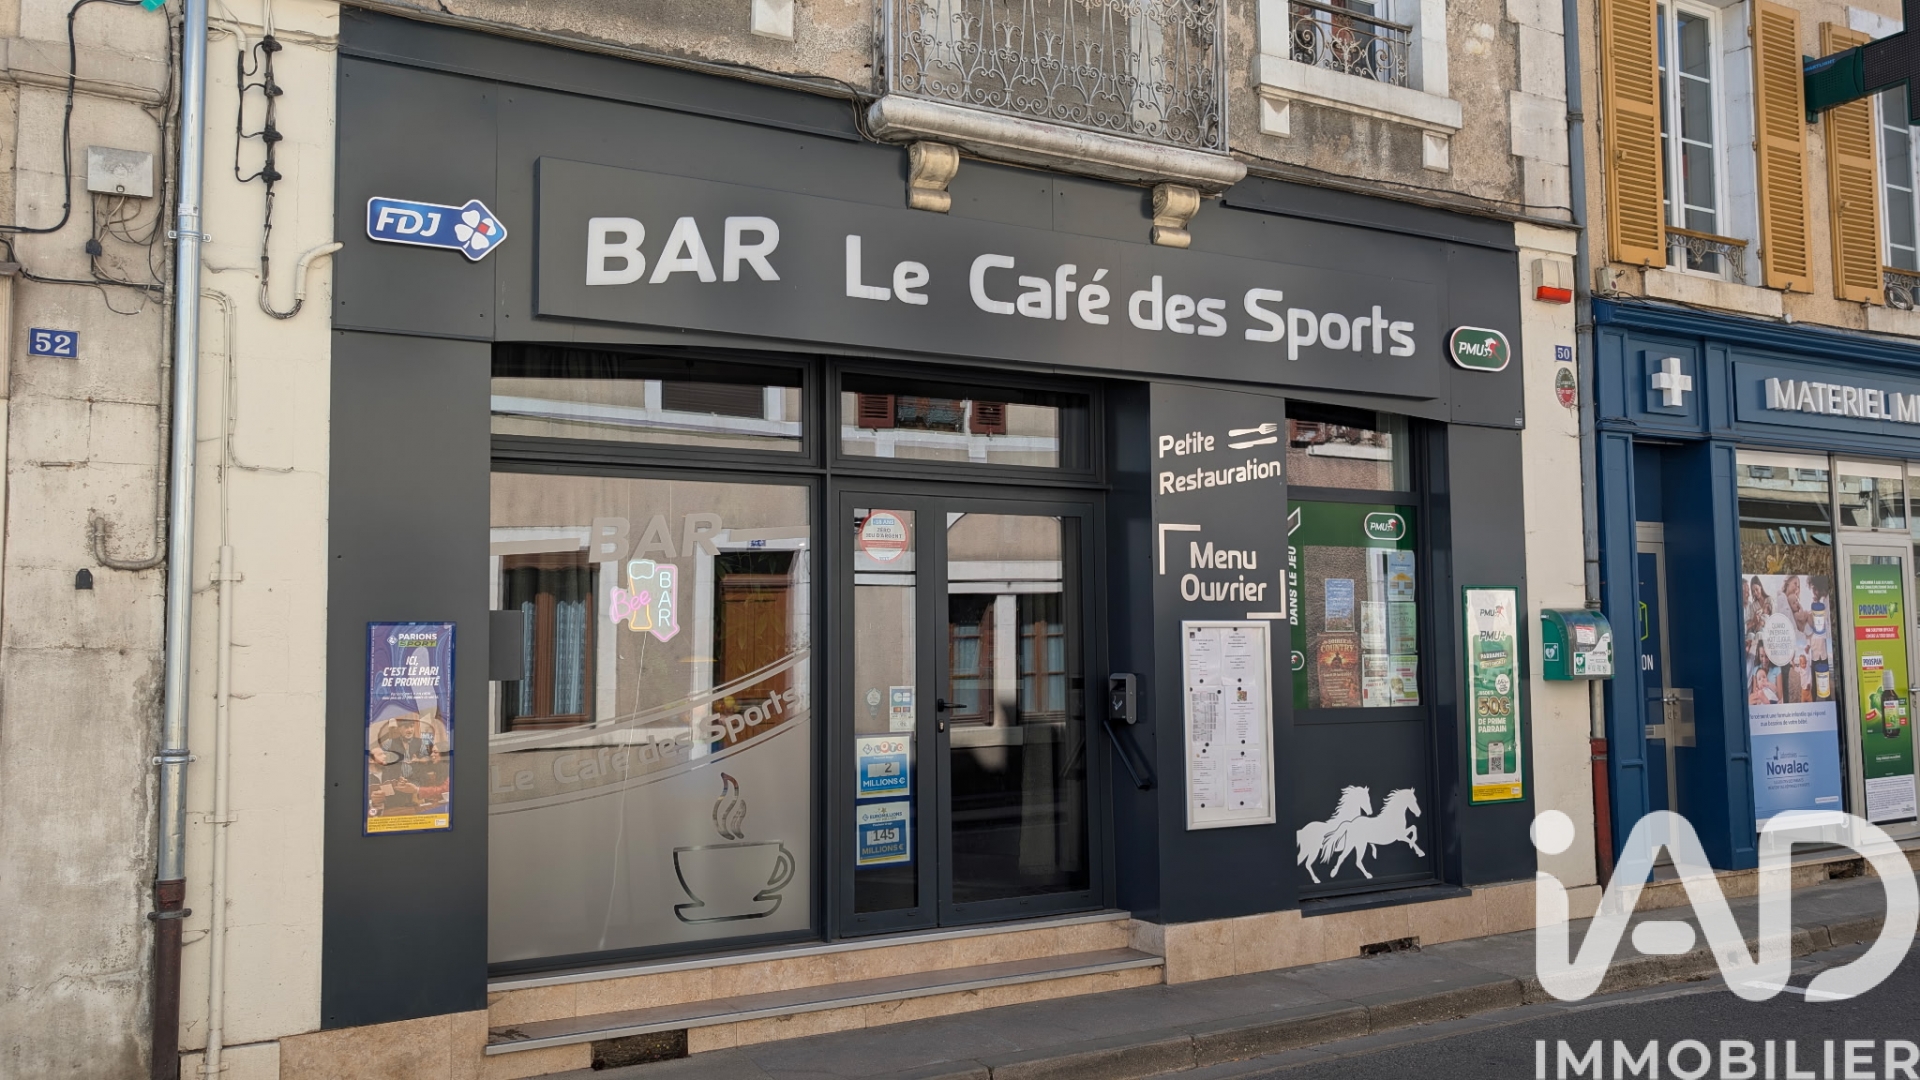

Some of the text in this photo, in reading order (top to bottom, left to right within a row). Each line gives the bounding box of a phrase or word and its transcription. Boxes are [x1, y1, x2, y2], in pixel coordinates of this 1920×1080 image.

[376, 207, 441, 237] FDJ
[586, 216, 1415, 361] BAR Le Café des Sports
[35, 332, 71, 354] 52
[1458, 341, 1484, 356] PMU
[1557, 347, 1570, 360] 50
[1765, 377, 1920, 423] MATERIEL M
[1158, 431, 1215, 458] Petite
[1159, 458, 1281, 495] Restauration
[1369, 521, 1388, 531] PMU
[589, 513, 723, 563] BAR
[1190, 541, 1257, 569] Menu
[1180, 574, 1268, 602] Ouvrier
[1287, 546, 1298, 626] DANS LE JEU
[658, 571, 672, 628] BAR
[1480, 608, 1495, 617] PMU
[1859, 604, 1887, 615] PROSPAN
[1321, 643, 1354, 652] COUNTRY
[405, 655, 419, 666] ICI,
[1862, 657, 1883, 665] PROSPAN
[383, 666, 440, 676] C'EST LE PARI
[381, 676, 440, 687] DE PROXIMITÉ
[1478, 725, 1507, 734] PARRAIN
[490, 686, 801, 794] Le Café des Sports
[874, 741, 904, 754] LOTO
[884, 763, 892, 773] 2
[1766, 760, 1809, 776] Novalac
[863, 778, 898, 788] MILLIONS
[873, 828, 895, 842] 145
[861, 845, 899, 856] MILLIONS
